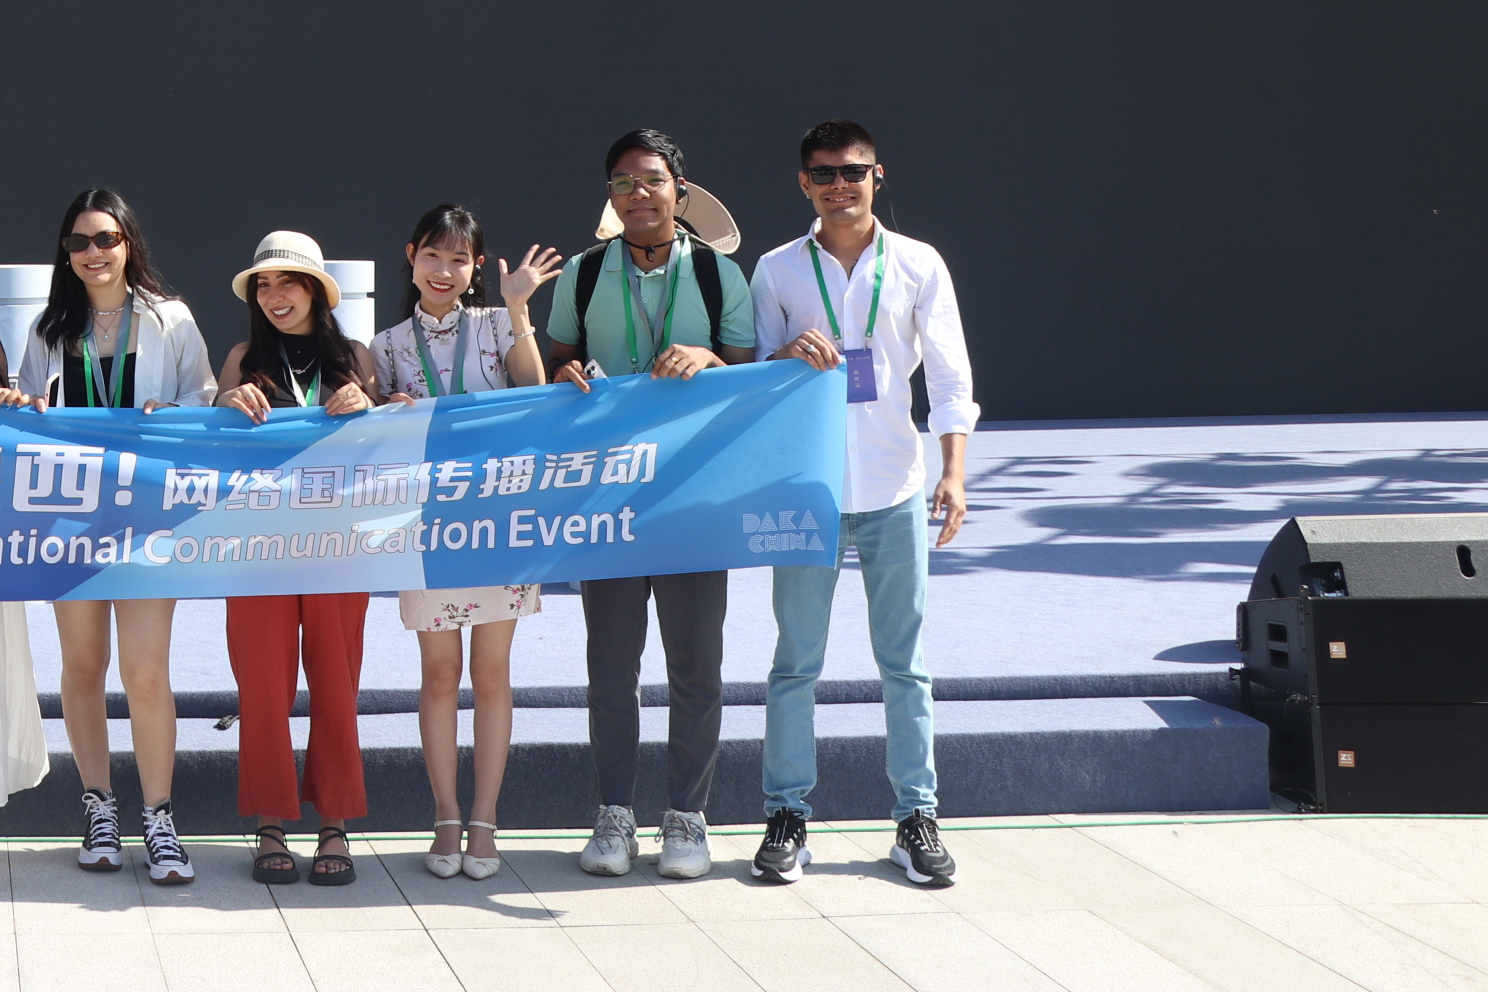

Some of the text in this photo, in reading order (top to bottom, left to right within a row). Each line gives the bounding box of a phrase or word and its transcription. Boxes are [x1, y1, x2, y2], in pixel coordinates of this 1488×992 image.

[742, 509, 820, 533] DAKA
[142, 515, 496, 566] Communication
[508, 506, 636, 549] Event
[748, 533, 825, 554] CHINA
